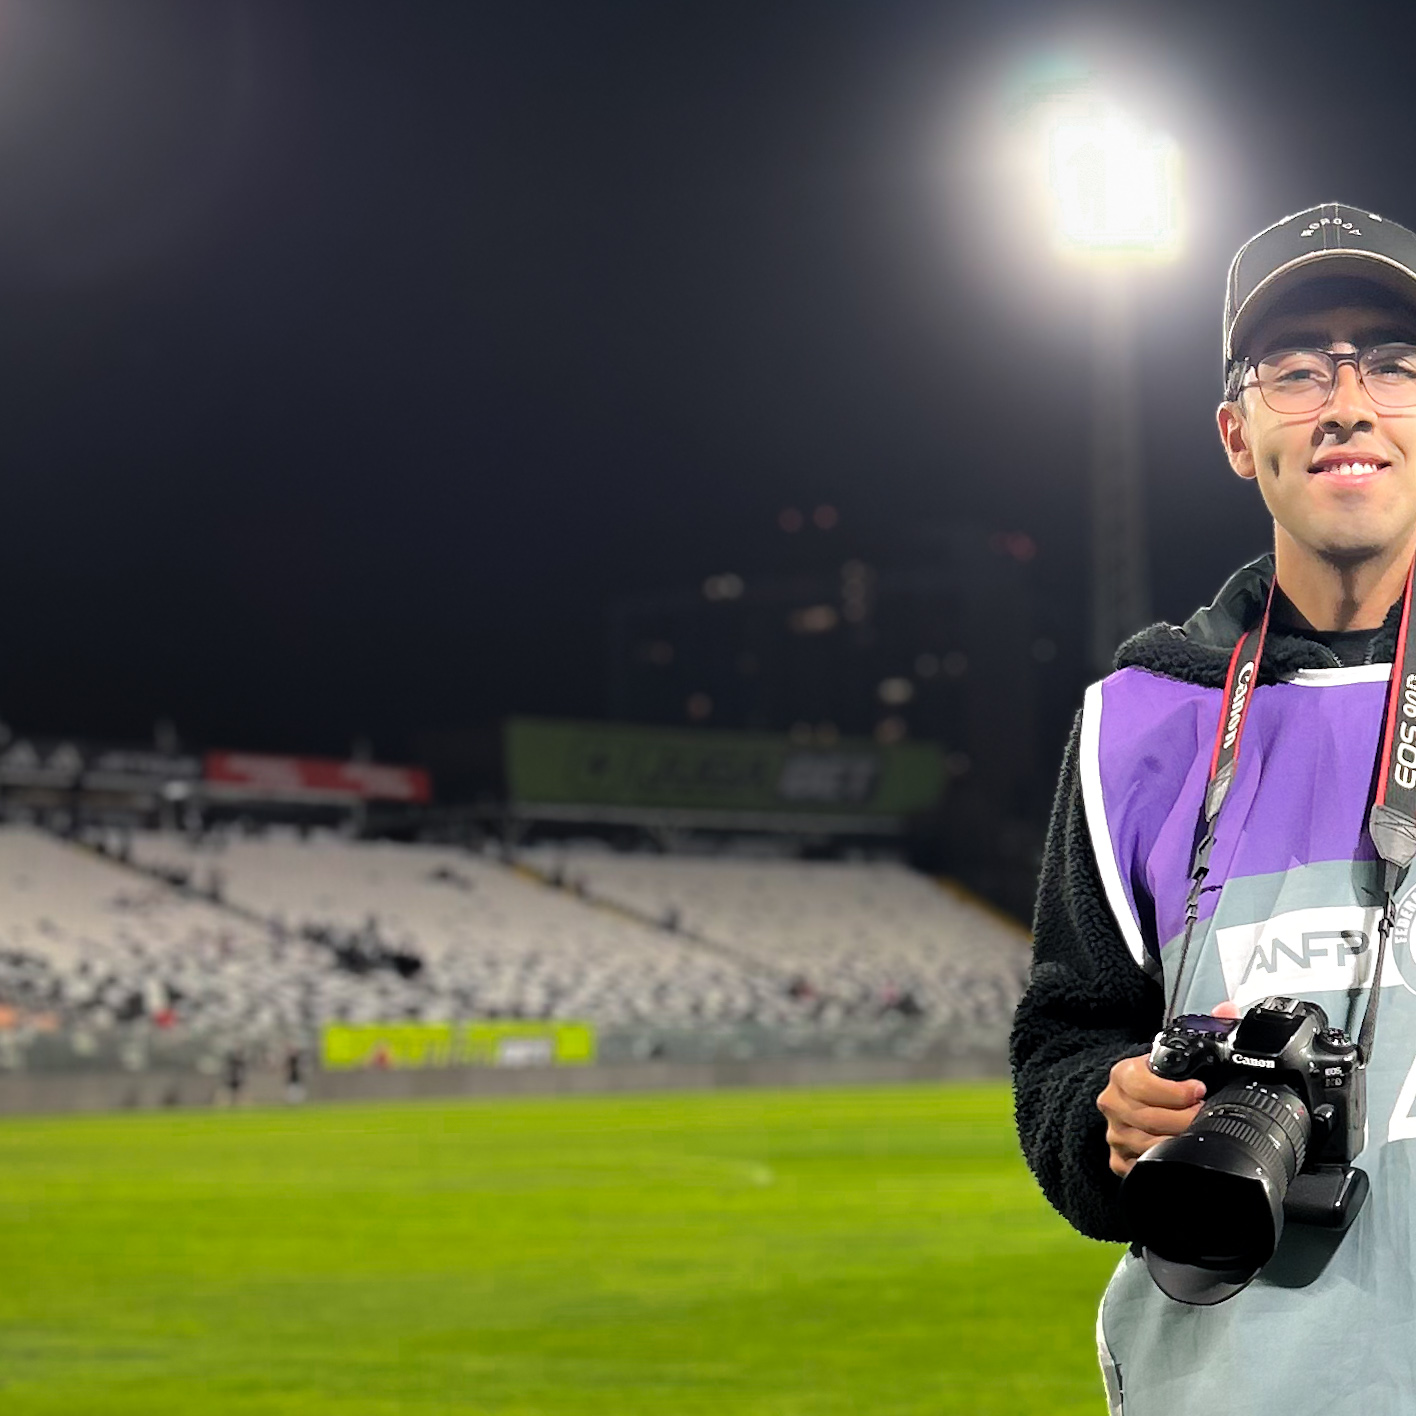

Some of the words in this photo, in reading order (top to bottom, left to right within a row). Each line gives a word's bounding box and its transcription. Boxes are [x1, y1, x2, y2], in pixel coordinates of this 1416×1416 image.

[1223, 661, 1255, 749] Canon
[1239, 929, 1370, 986] ANFP
[1231, 1053, 1276, 1069] Canon
